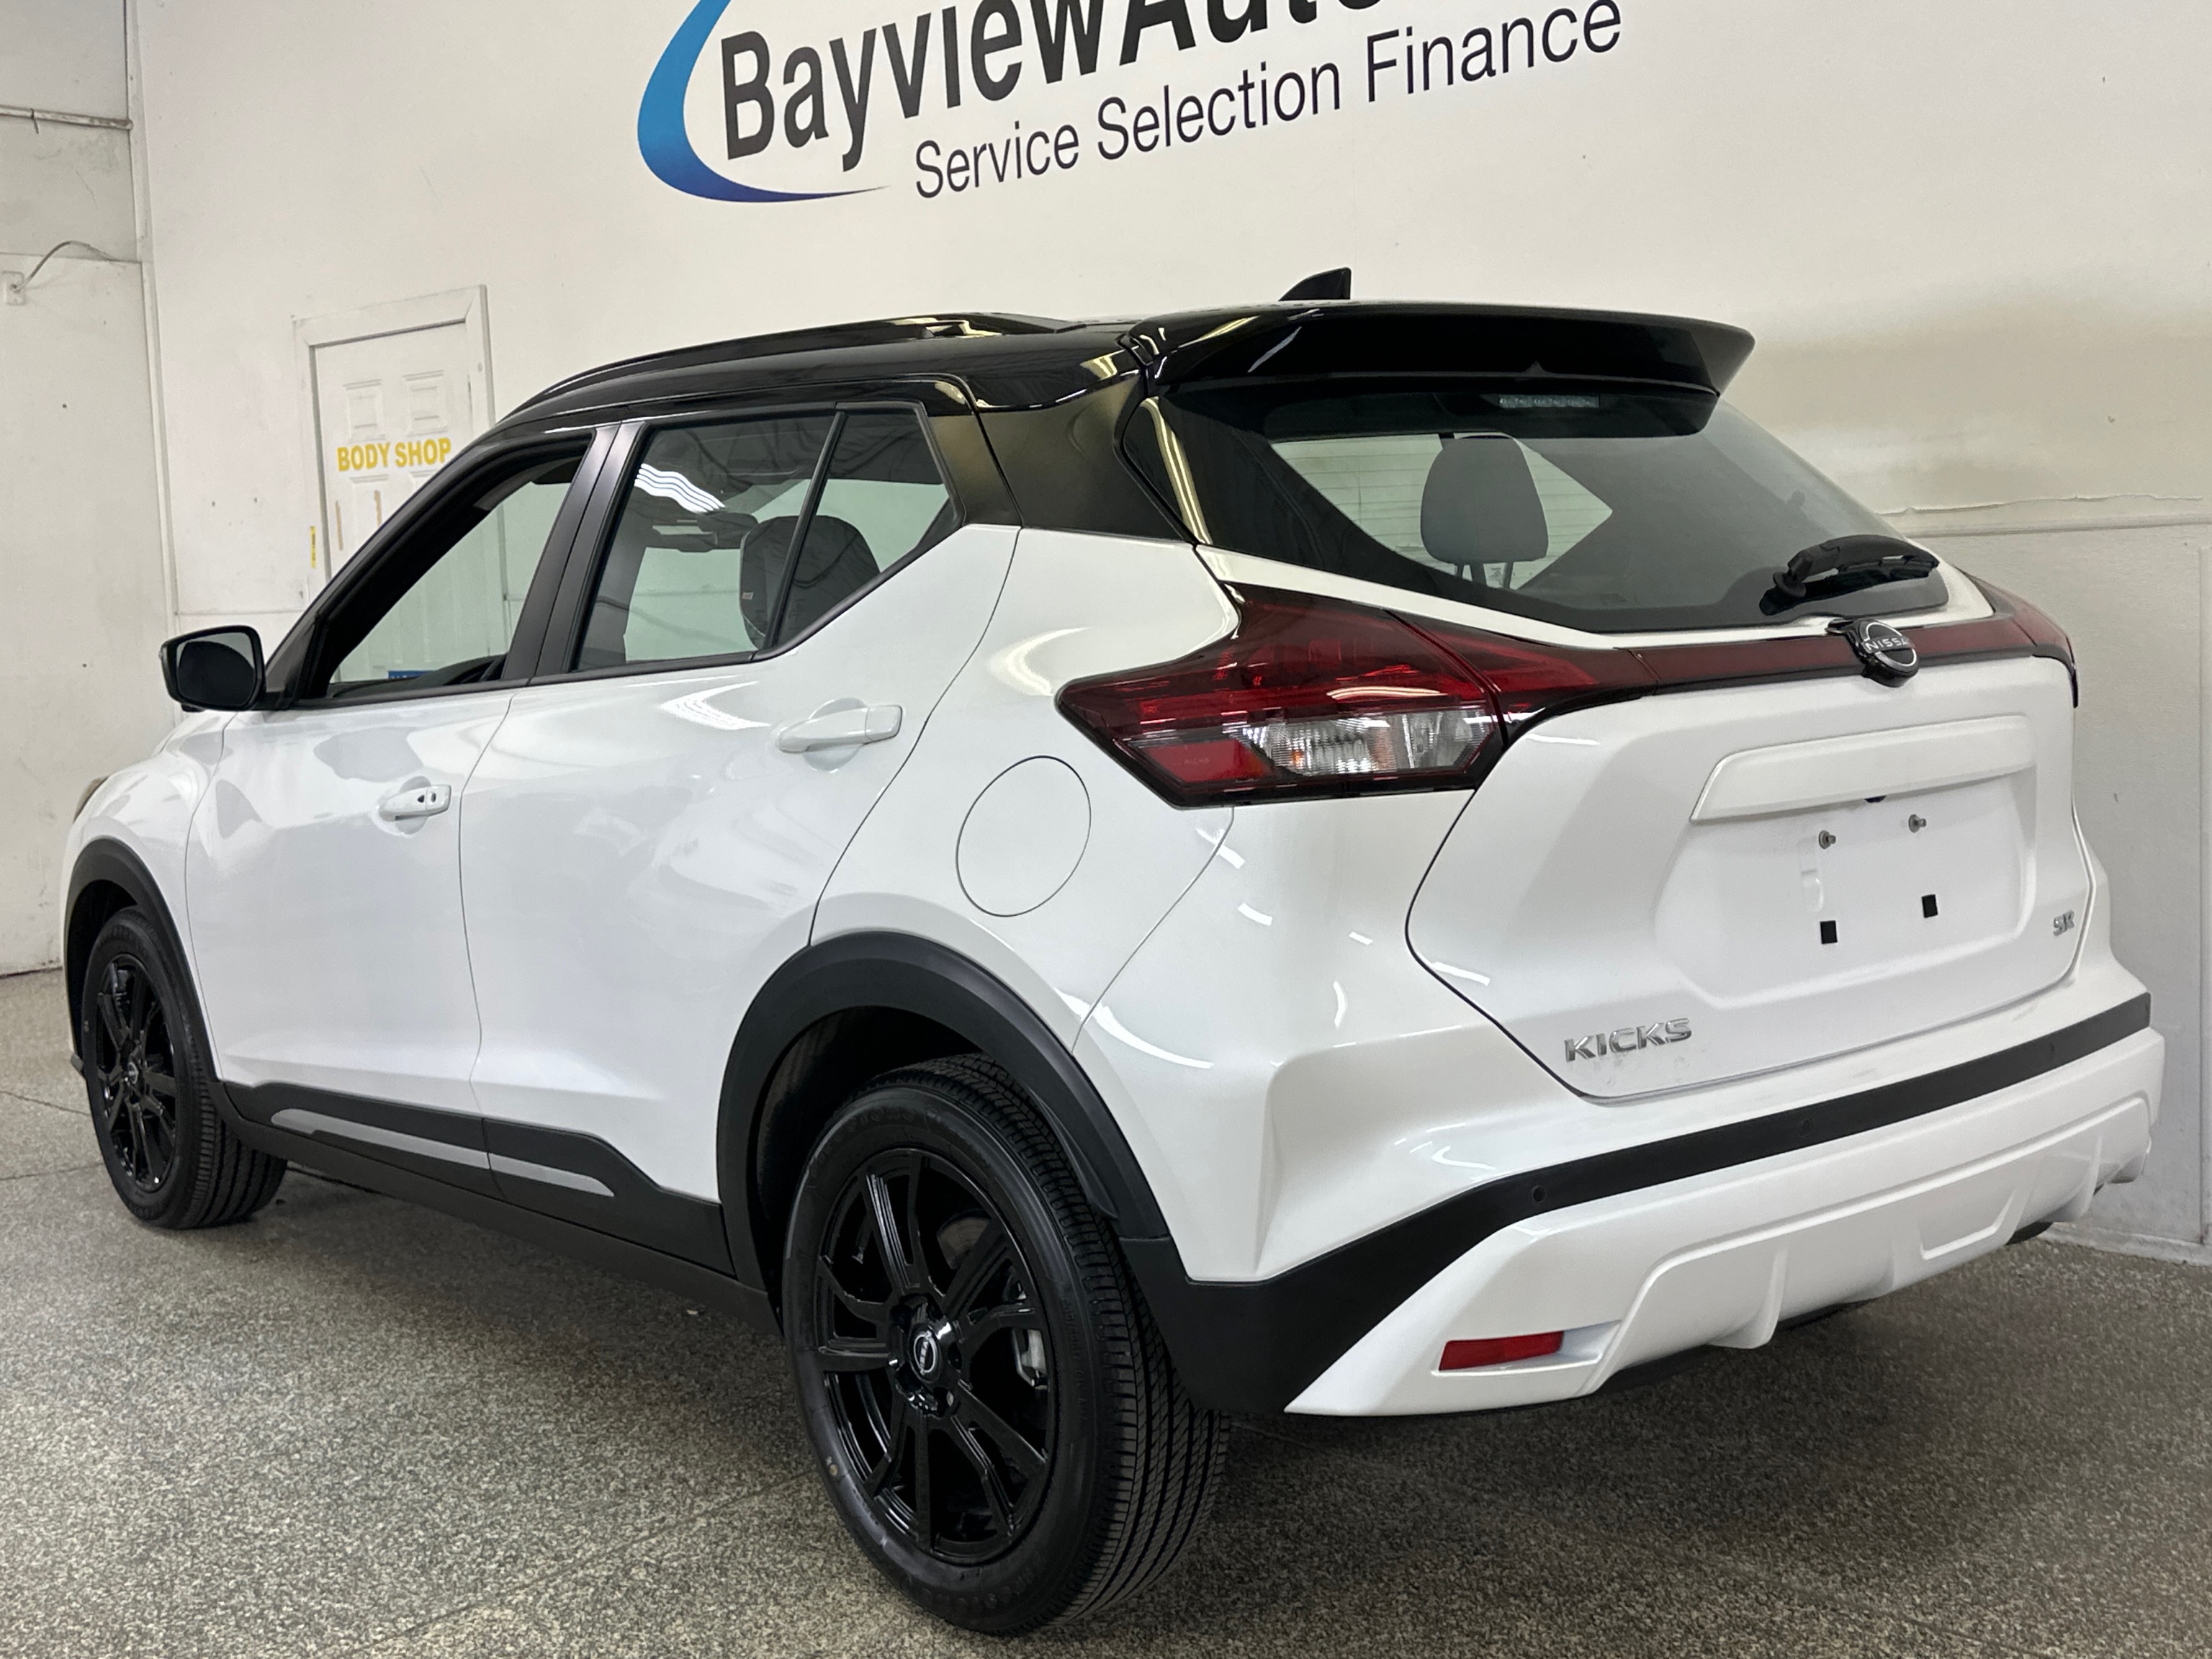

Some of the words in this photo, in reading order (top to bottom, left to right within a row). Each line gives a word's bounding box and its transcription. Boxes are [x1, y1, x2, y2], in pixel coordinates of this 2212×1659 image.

[721, 0, 1382, 172] Bayview
[915, 120, 1079, 199] Service
[1097, 60, 1340, 160] Selection
[1367, 0, 1622, 103] Finance
[337, 442, 390, 471] BODY
[395, 438, 451, 467] SHOP
[2054, 909, 2074, 937] SR
[1564, 1017, 1692, 1063] KICKS
